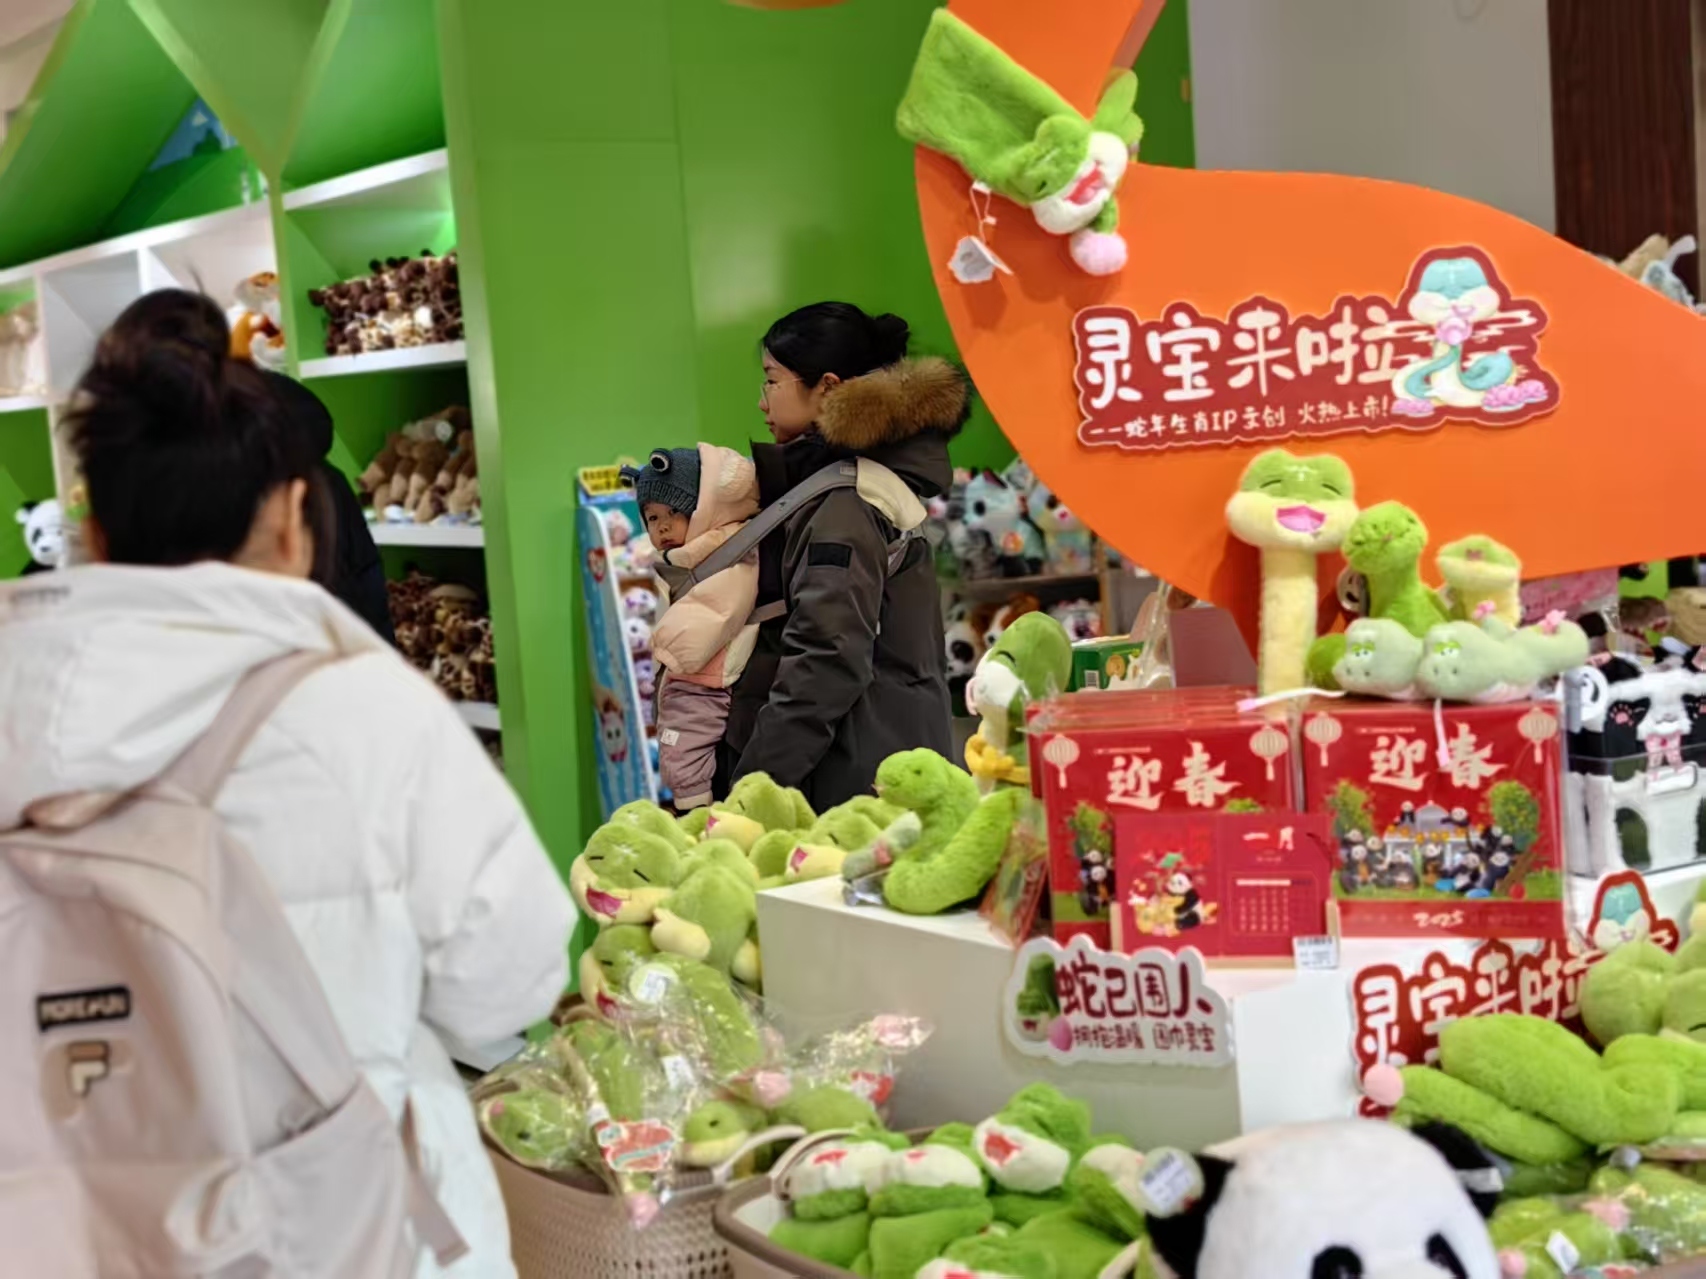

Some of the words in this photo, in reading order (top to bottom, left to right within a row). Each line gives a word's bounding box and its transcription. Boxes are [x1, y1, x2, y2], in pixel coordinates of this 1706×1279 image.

[1083, 306, 1396, 408] 灵宝来啦
[1106, 740, 1242, 810] 迎春
[1369, 722, 1506, 790] 迎春
[1243, 826, 1294, 850] 一月
